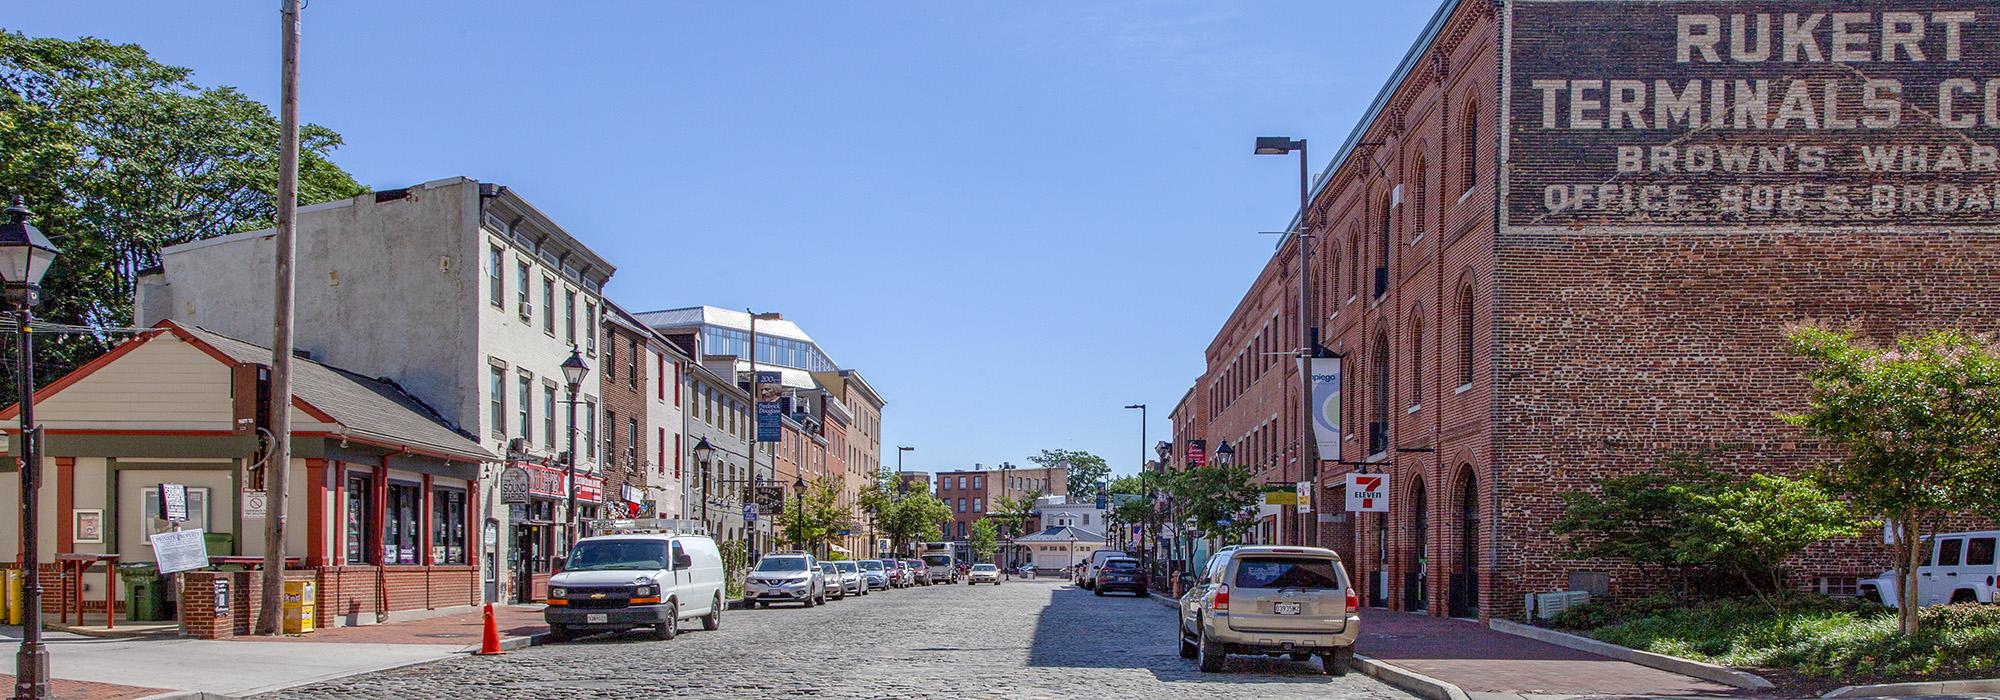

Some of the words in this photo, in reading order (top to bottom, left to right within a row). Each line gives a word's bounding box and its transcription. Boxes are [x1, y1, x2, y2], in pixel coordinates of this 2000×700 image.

[1676, 11, 1976, 63] RUKERT
[1532, 78, 1902, 130] TERMINALS
[1616, 143, 1827, 173] BROWN'S
[1544, 184, 1690, 211] OFFICE
[503, 483, 527, 493] SOUND
[1356, 476, 1381, 508] 7
